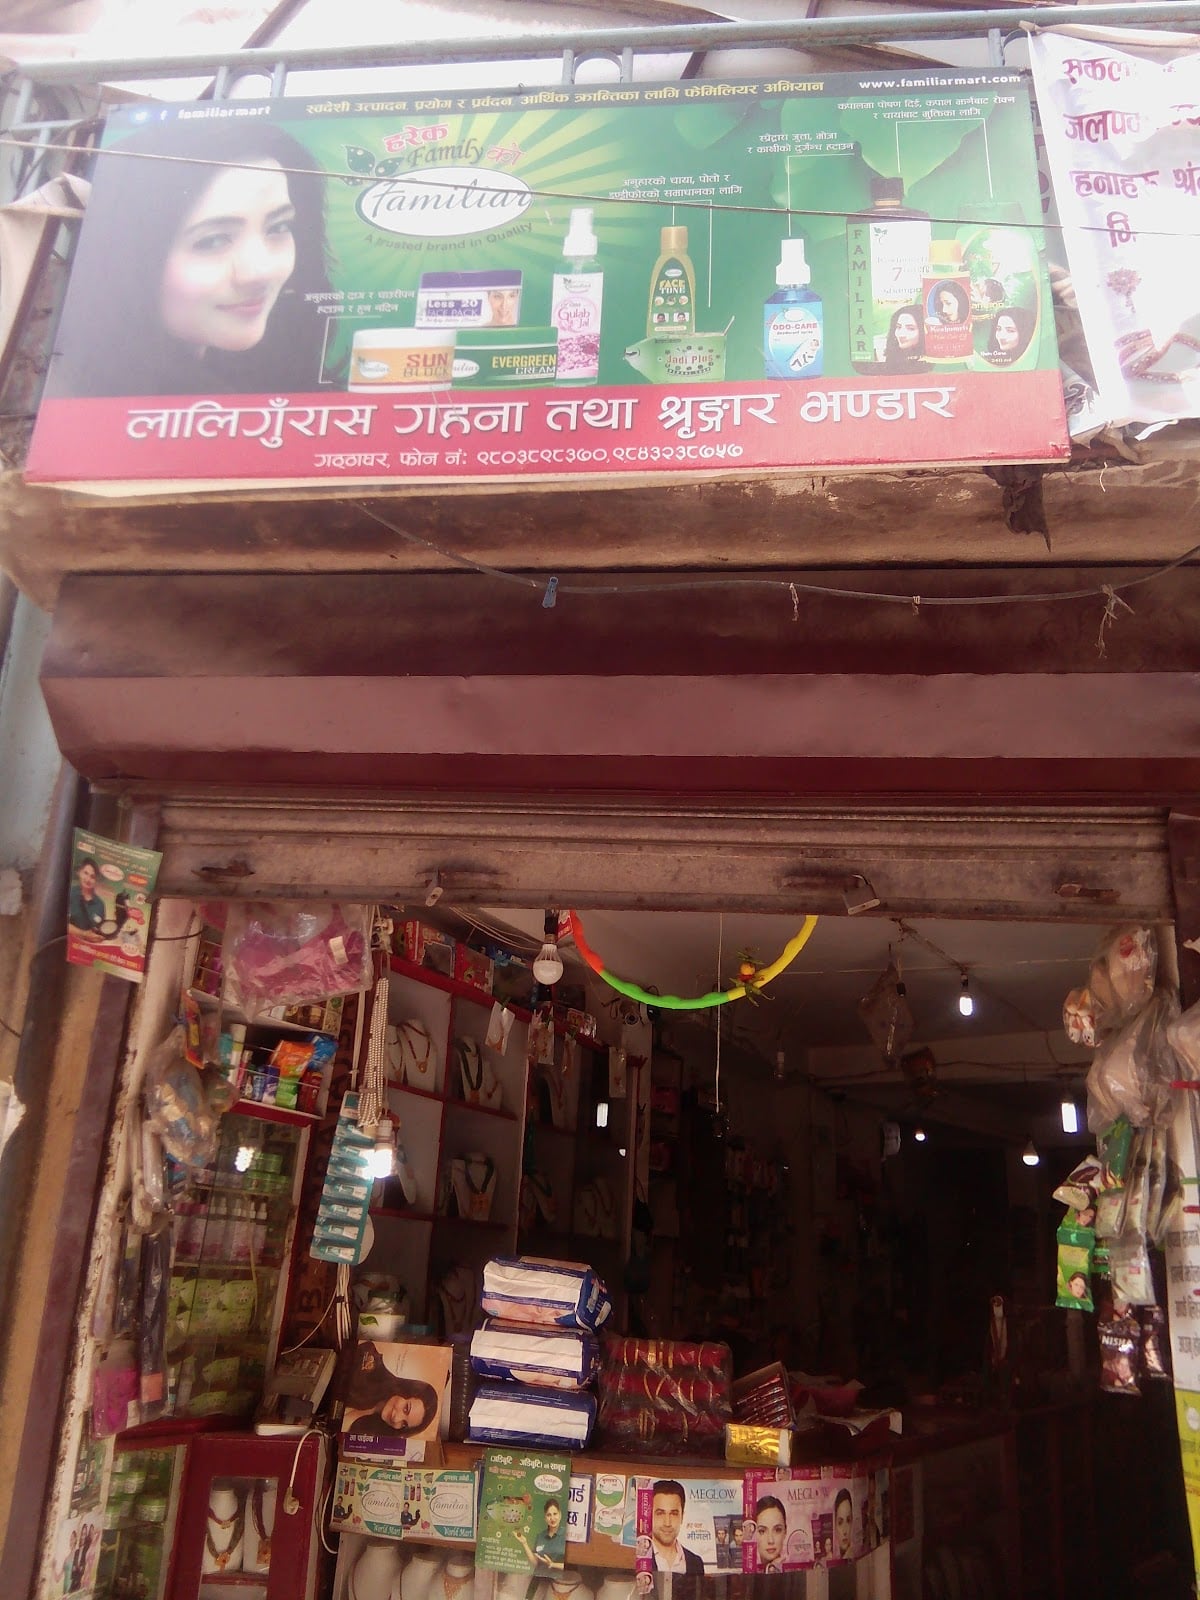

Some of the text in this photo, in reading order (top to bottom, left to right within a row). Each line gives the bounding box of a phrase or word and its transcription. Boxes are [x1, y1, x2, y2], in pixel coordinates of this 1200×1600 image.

[859, 76, 1021, 89] www.familiarmart.com
[306, 101, 350, 114] स्वदेशी
[415, 98, 452, 111] प्रयोग
[457, 98, 465, 109] र
[520, 92, 569, 105] आर्थिक
[645, 87, 680, 101] लागि
[685, 83, 759, 98] फेमिलियर
[763, 80, 825, 94] अभियान
[178, 106, 271, 120] familiarmart
[959, 107, 981, 117] लागि
[384, 124, 449, 153] हरेक
[407, 138, 484, 167] Family
[719, 184, 743, 195] लागि
[376, 237, 423, 252] trusted
[427, 239, 466, 252] brand
[470, 238, 483, 248] in
[487, 223, 533, 243] Quality
[659, 279, 686, 288] FACE
[428, 299, 479, 308] Less 20
[558, 307, 591, 321] Gulab
[772, 321, 818, 331] ODO-CARE
[407, 353, 449, 368] SUN
[492, 354, 557, 368] EVERGREEN
[516, 366, 556, 375] CREAM
[393, 402, 529, 439] गहना
[545, 398, 639, 432] तथा
[800, 386, 957, 424] भण्डार
[400, 448, 440, 467] फोन
[1101, 1334, 1134, 1350] NISHA
[689, 1488, 737, 1500] MEGLOW
